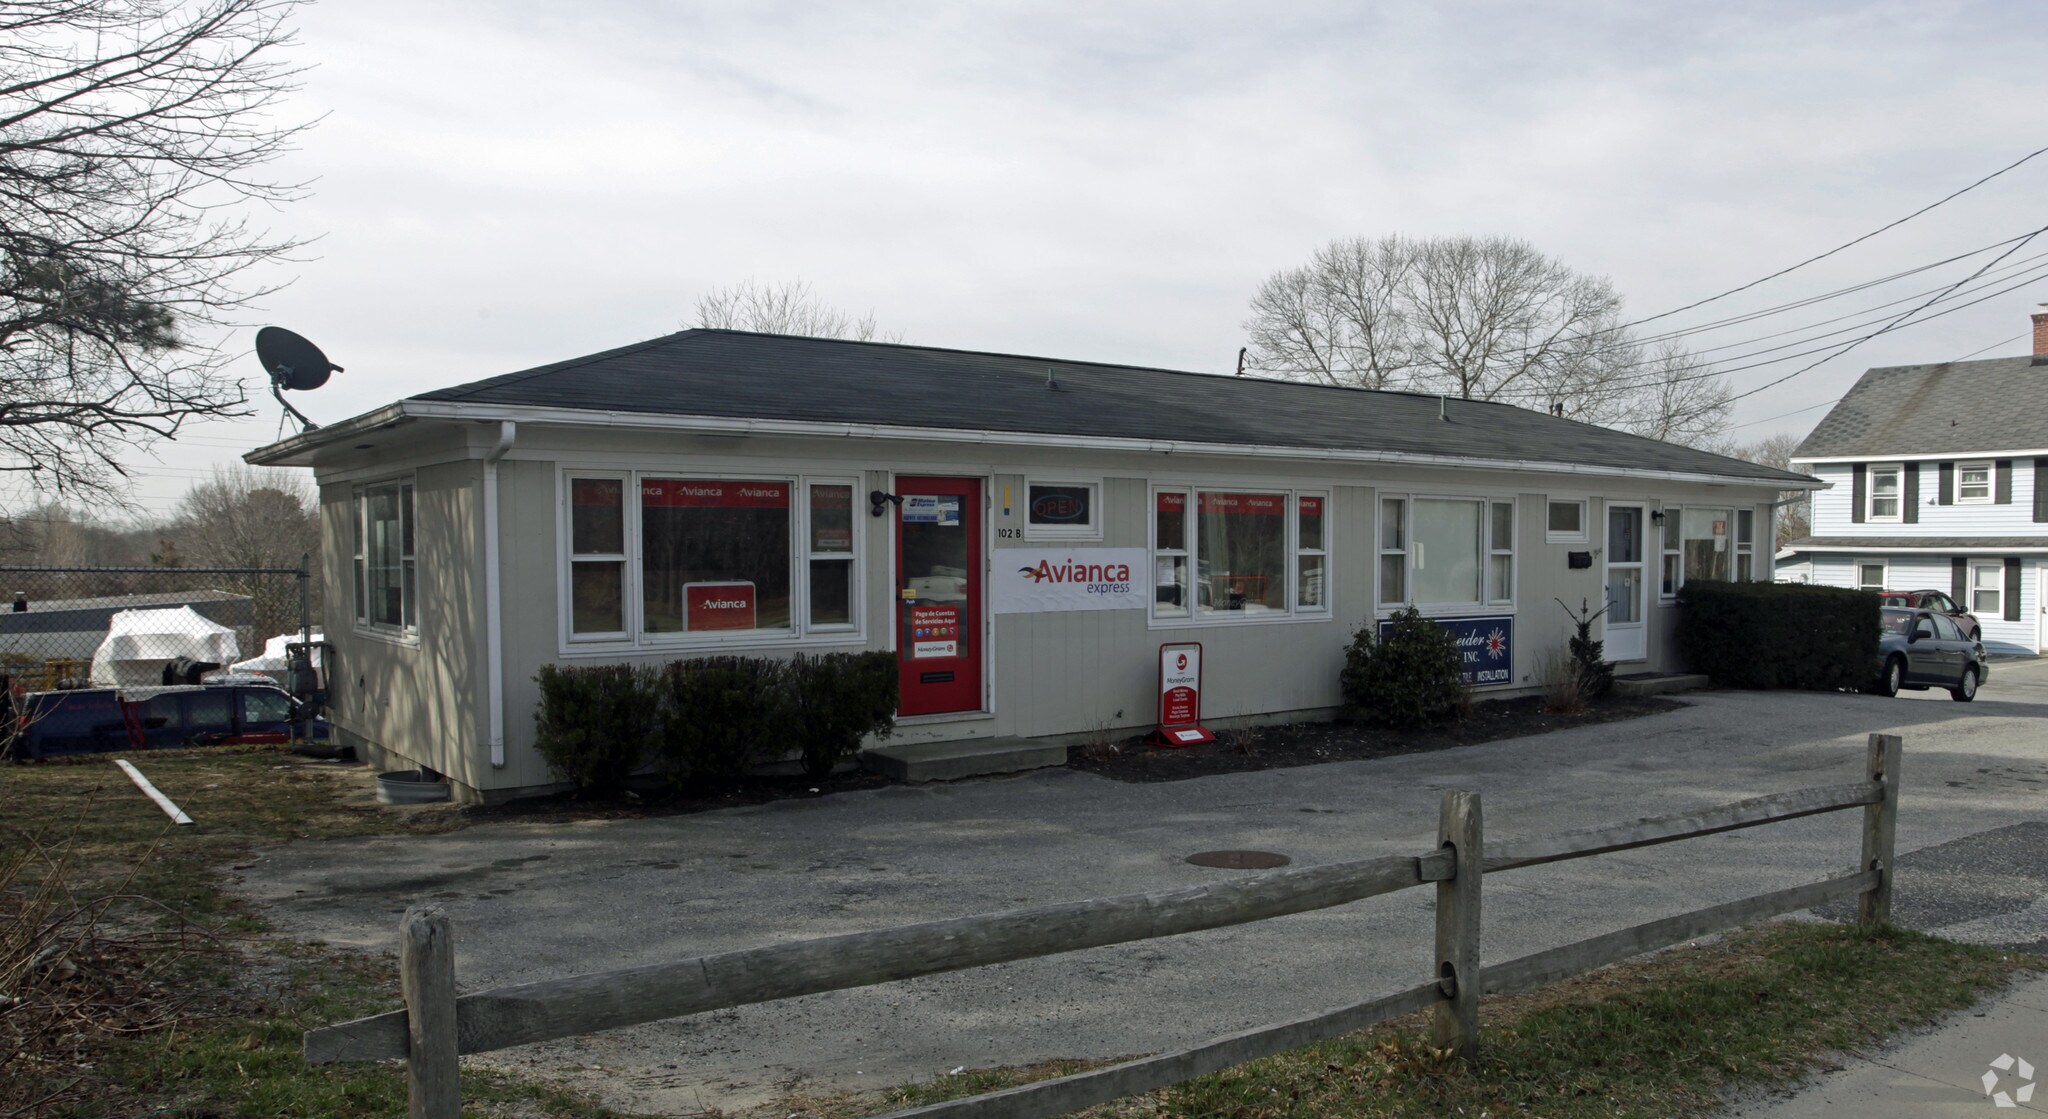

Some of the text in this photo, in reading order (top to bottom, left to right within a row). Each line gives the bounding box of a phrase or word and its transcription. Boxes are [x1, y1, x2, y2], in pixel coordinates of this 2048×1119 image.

[680, 486, 723, 497] Avianca
[740, 487, 780, 498] Avianca
[1034, 500, 1079, 516] OPEN
[1212, 497, 1238, 507] Avianca
[1248, 498, 1273, 508] Avianca
[998, 528, 1021, 538] 102 B
[1034, 558, 1130, 584] Avianca
[1087, 583, 1130, 596] express
[703, 598, 747, 610] Avianca
[935, 609, 955, 617] Cuentas
[1463, 650, 1480, 663] INC.
[1166, 676, 1196, 685] MoneyGram
[1477, 668, 1508, 682] INSTALLATION
